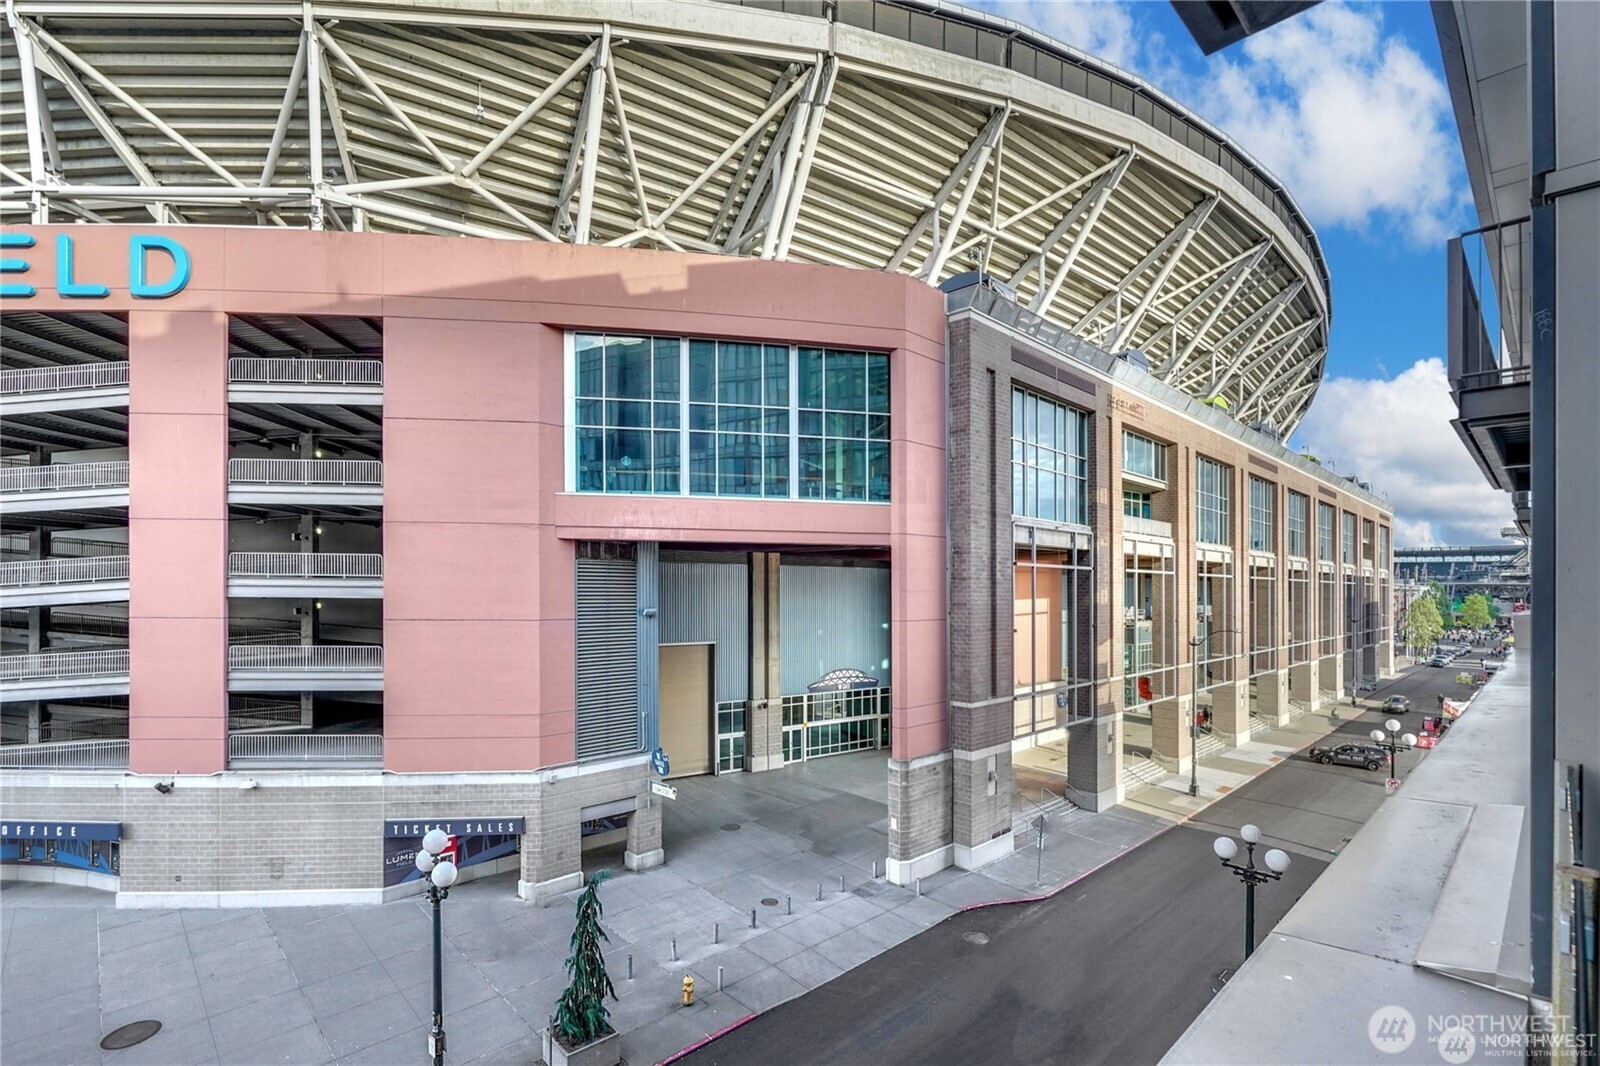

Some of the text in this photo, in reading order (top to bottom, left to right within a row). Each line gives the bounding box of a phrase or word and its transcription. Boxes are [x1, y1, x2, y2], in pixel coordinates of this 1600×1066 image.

[0, 233, 191, 298] ELD
[1, 825, 76, 837] OFFICE
[393, 822, 514, 835] TICKET SALES
[386, 852, 418, 865] LUME
